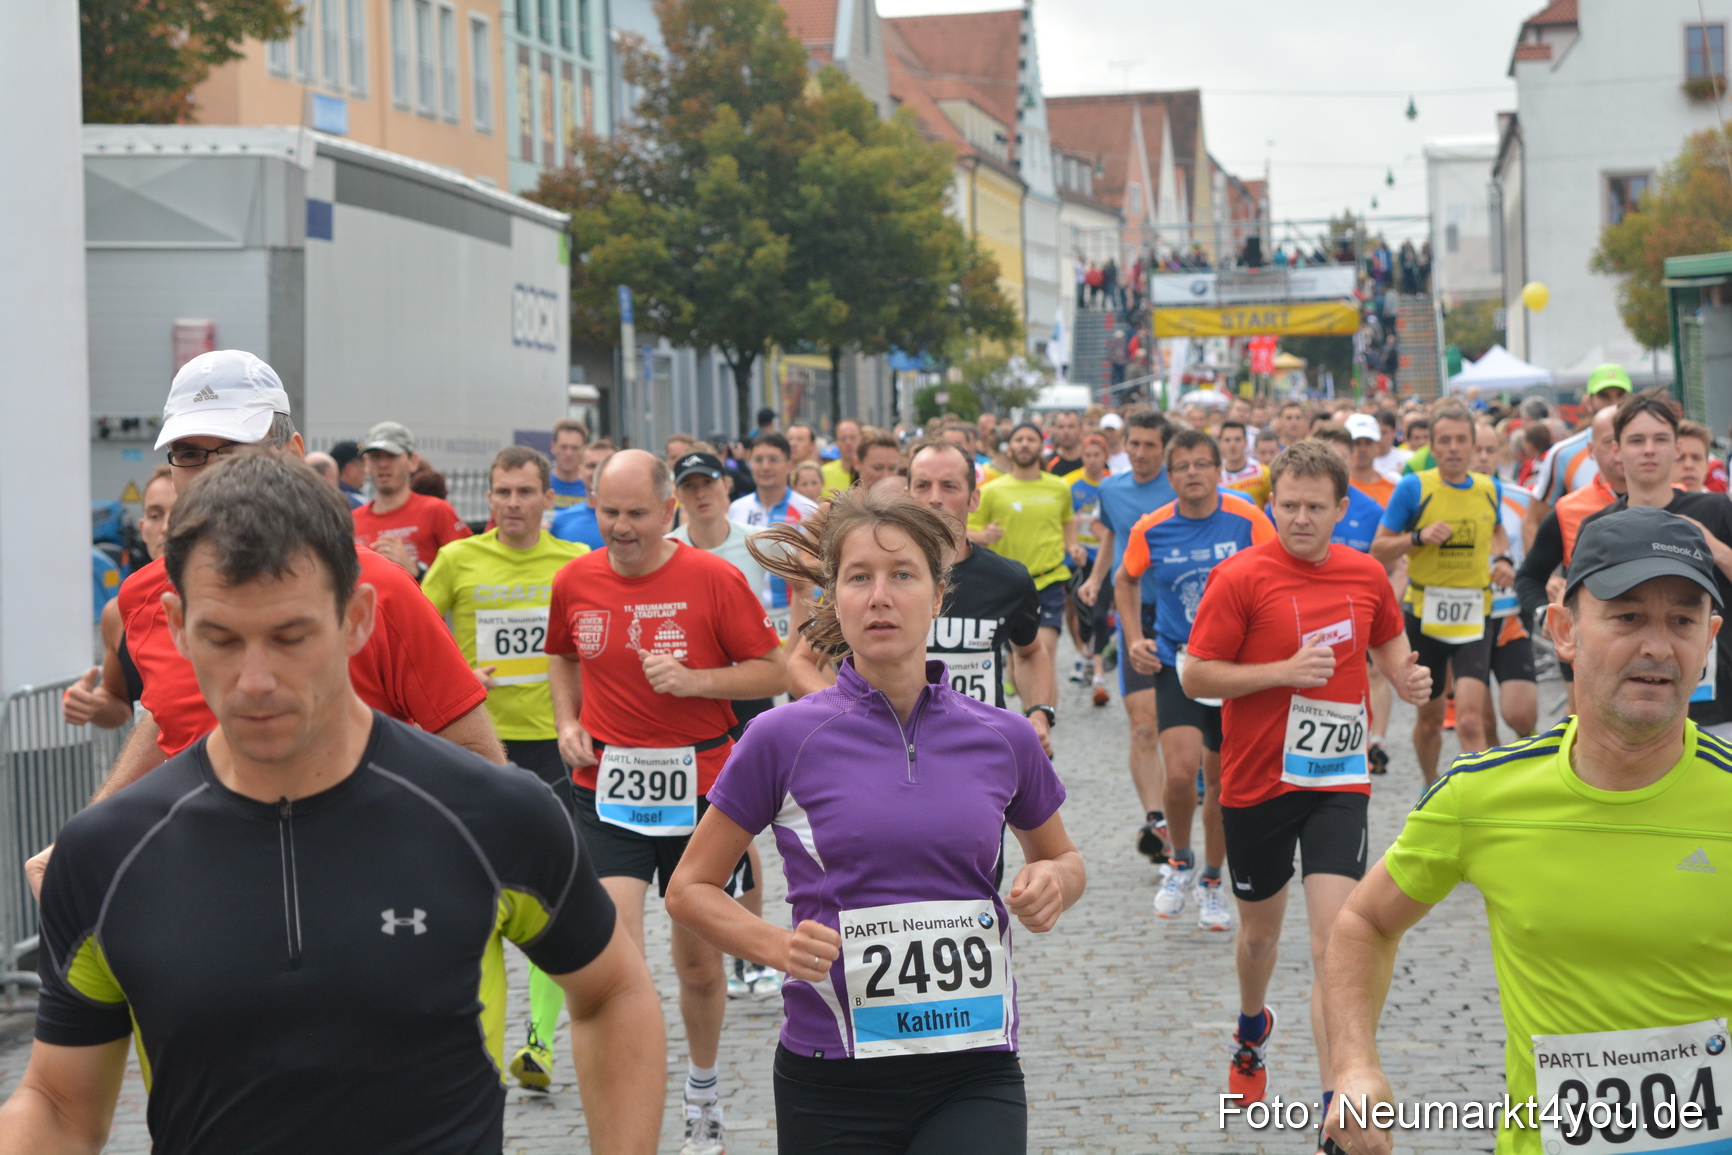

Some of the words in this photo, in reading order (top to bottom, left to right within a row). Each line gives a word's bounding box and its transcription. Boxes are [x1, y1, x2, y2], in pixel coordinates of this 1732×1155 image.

[1220, 310, 1291, 329] START
[193, 392, 219, 402] addas
[1651, 542, 1692, 557] Reebok
[474, 584, 551, 602] CRAFT
[633, 609, 678, 619] STADTLAUF
[635, 602, 688, 611] NEUMARKTER
[1436, 601, 1473, 622] 607
[495, 626, 546, 655] 632
[926, 616, 999, 649] ULE
[1292, 704, 1325, 717] PARTL
[1295, 719, 1364, 754] 2790
[603, 753, 632, 765] PARTL
[633, 756, 680, 766] Neumarkt
[1306, 760, 1347, 776] Thomas
[607, 767, 688, 802] 2390
[628, 810, 664, 824] Josef
[843, 920, 900, 940] PARTL
[902, 915, 975, 932] Neumarkt
[862, 936, 993, 999] 2499
[896, 1007, 972, 1034] Kathrin
[1538, 1051, 1599, 1069] PARTL
[1602, 1043, 1698, 1067] Neumarkt
[1557, 1066, 1724, 1147] 3304
